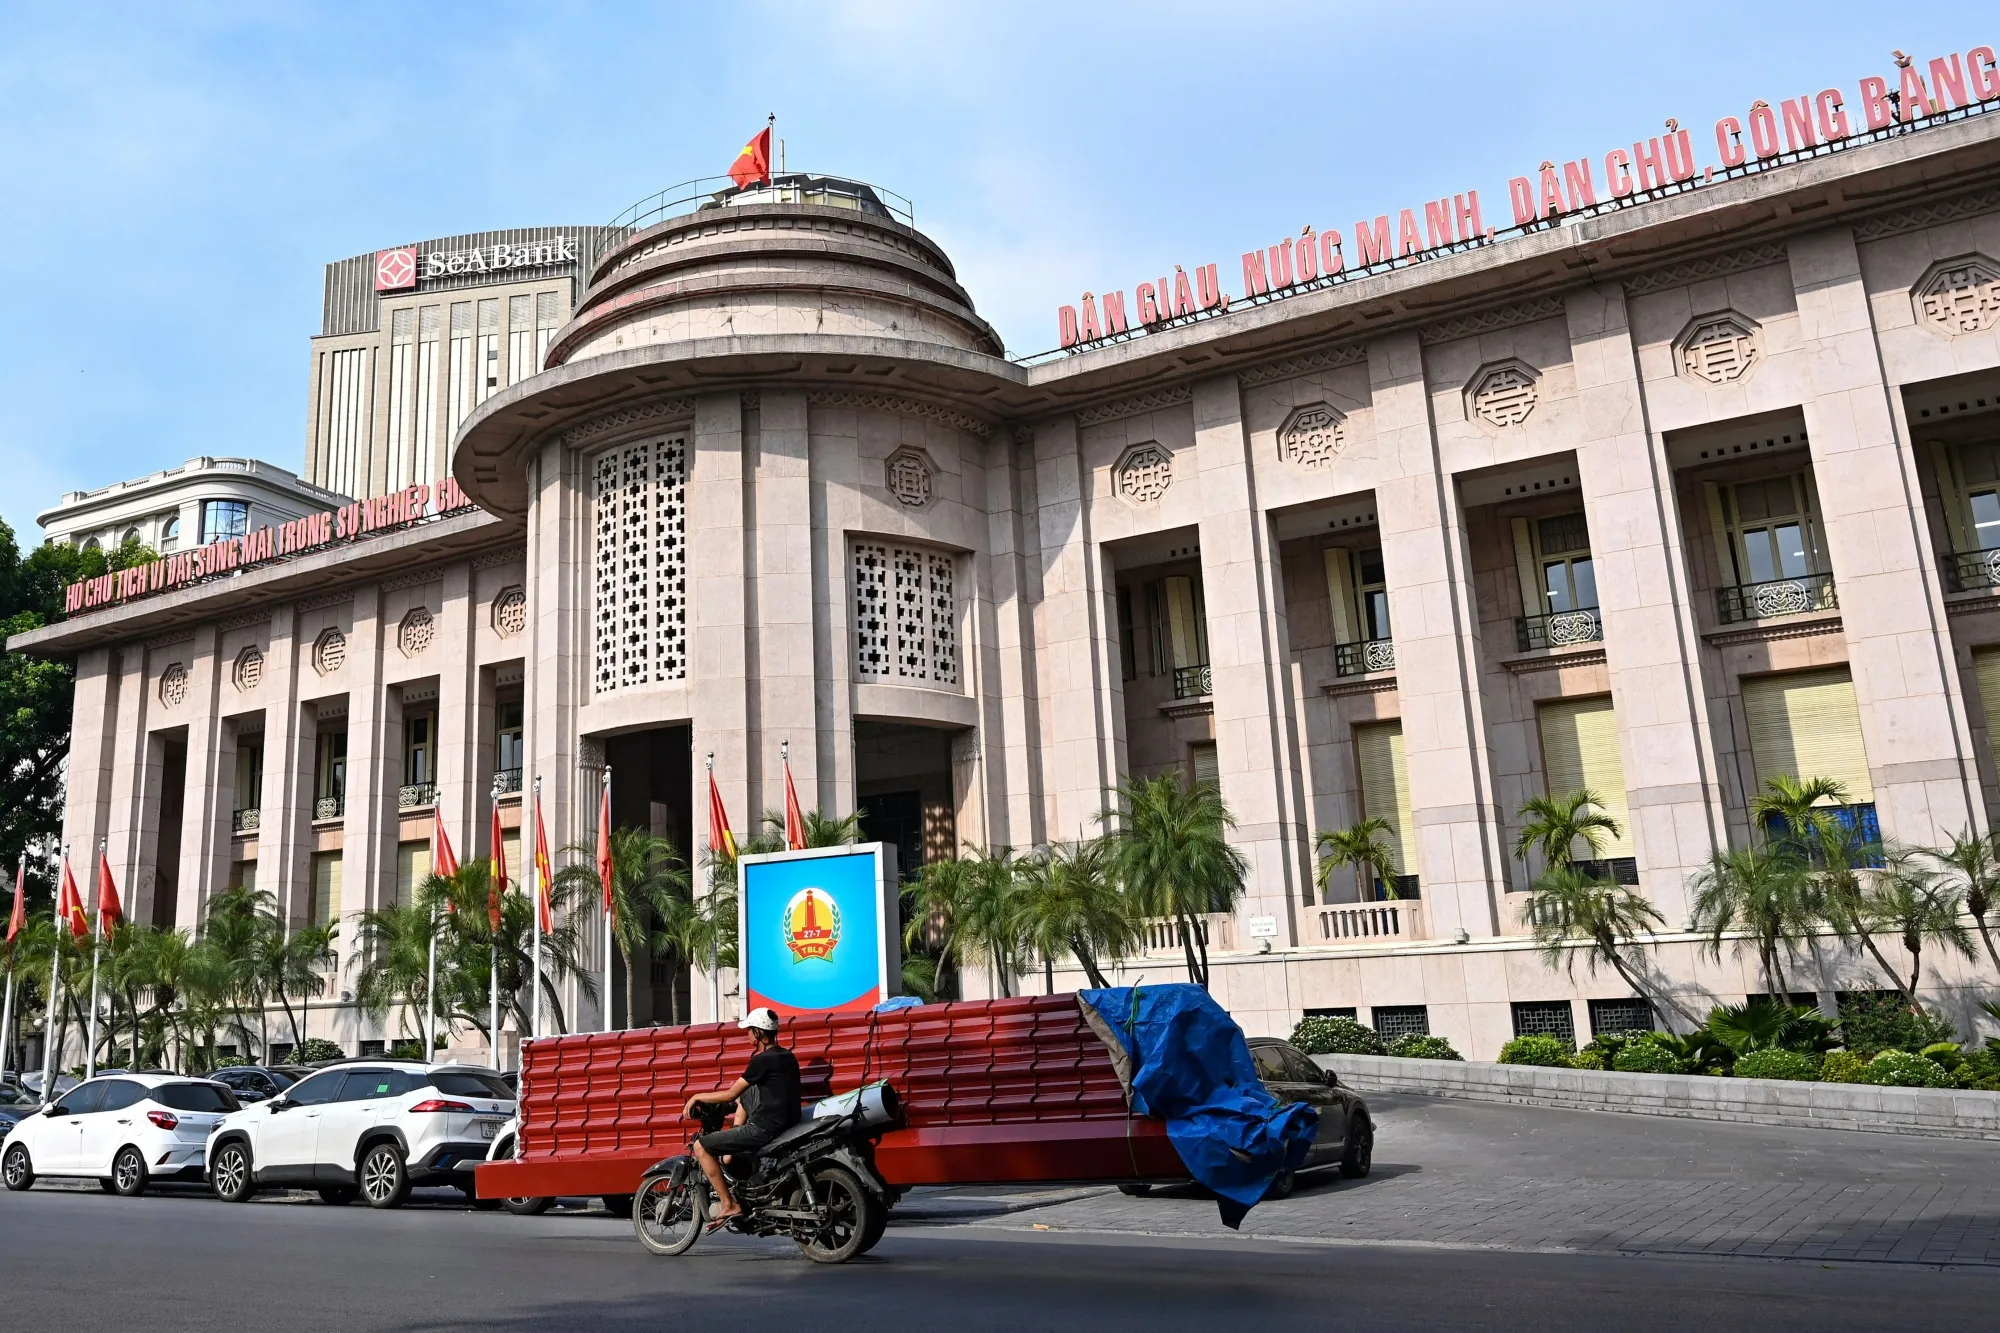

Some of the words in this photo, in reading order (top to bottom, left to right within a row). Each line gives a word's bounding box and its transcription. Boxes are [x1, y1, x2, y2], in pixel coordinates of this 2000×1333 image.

[1058, 291, 1126, 349] DÂN
[1136, 265, 1230, 325] GIÀU,
[1241, 225, 1343, 298] NƯỚC
[1354, 188, 1495, 268] MẠNH,
[1508, 158, 1597, 226] DÂN
[1604, 117, 1713, 198] CHỦ,
[1715, 88, 1851, 168] CÔNG
[1859, 50, 2000, 132] BẰNG
[427, 235, 576, 277] SeABank
[65, 574, 83, 613] HỒ
[85, 564, 114, 608] CHỦ
[117, 563, 149, 604] TỊCH
[196, 535, 240, 578] SỐNG
[278, 511, 333, 556] TRONG
[363, 481, 430, 533] NGHIỆP
[801, 946, 824, 954] TBLS
[803, 930, 820, 938] 27-7
